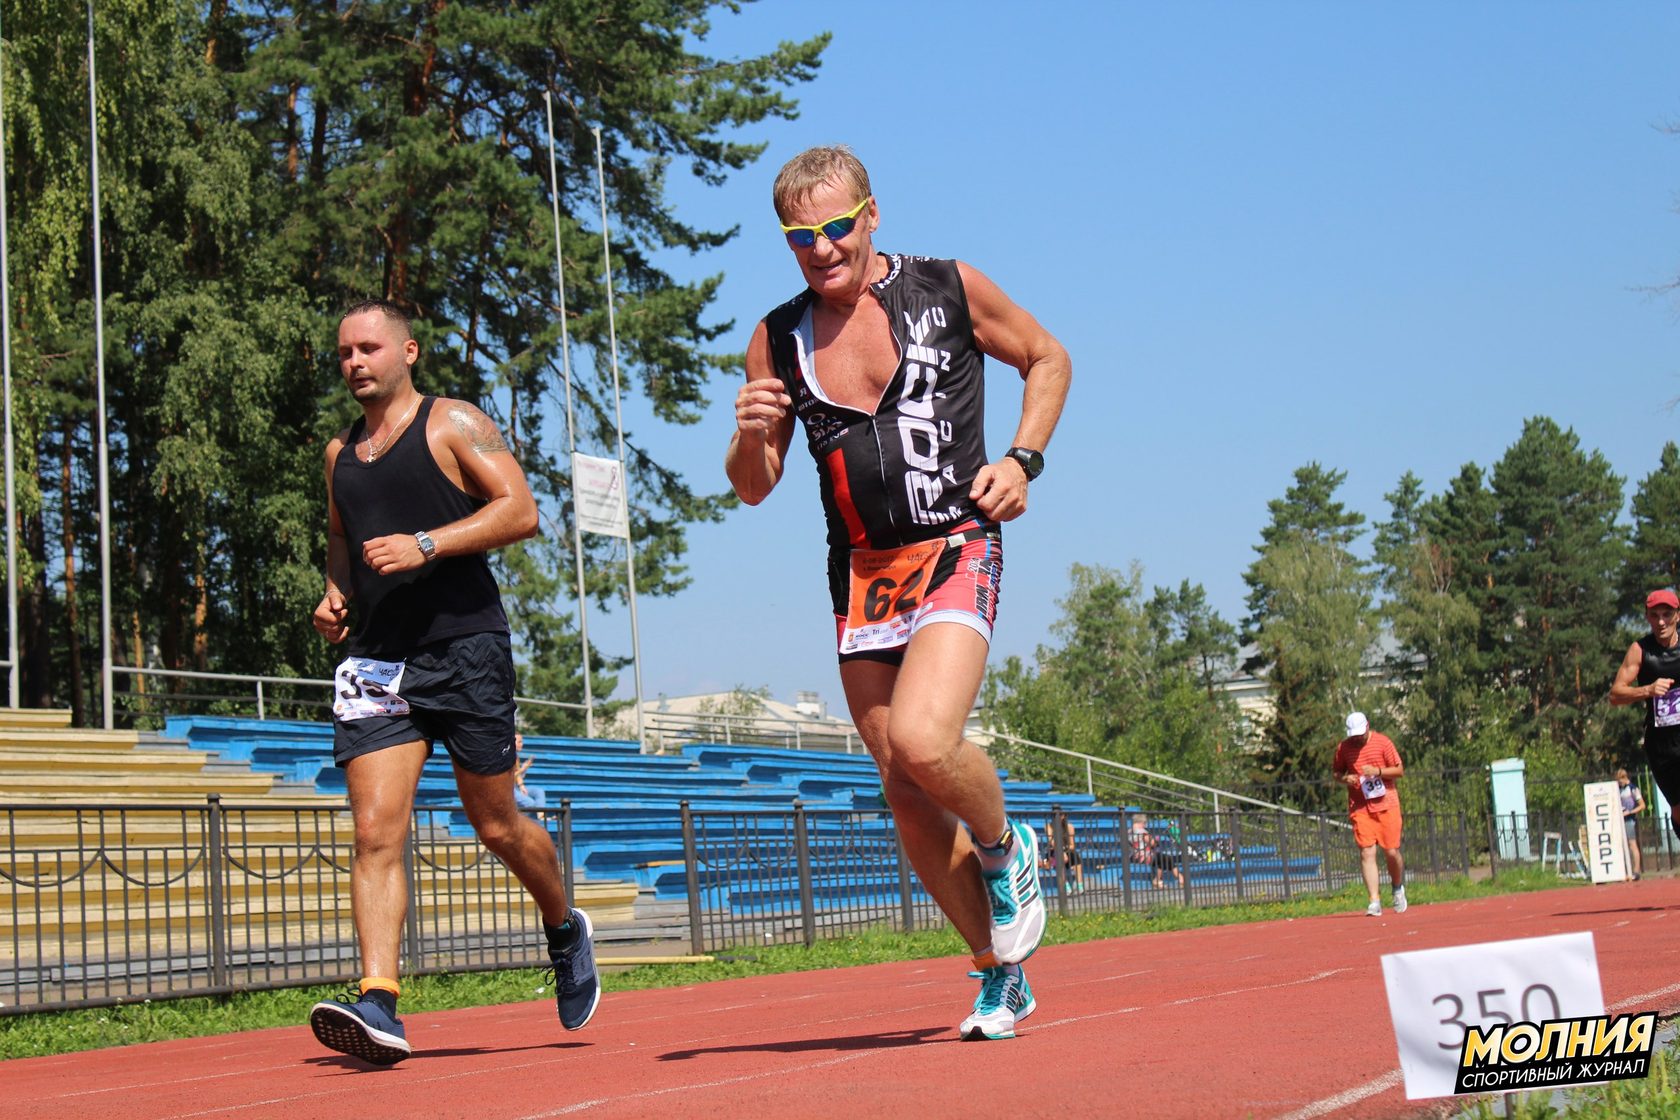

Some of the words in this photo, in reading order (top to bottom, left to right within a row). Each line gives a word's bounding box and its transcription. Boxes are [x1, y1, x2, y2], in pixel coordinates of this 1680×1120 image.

[896, 308, 950, 525] ROCK
[931, 306, 962, 522] RACING
[864, 568, 924, 622] 62
[1365, 778, 1382, 792] 39
[1595, 803, 1613, 875] СТАРТ
